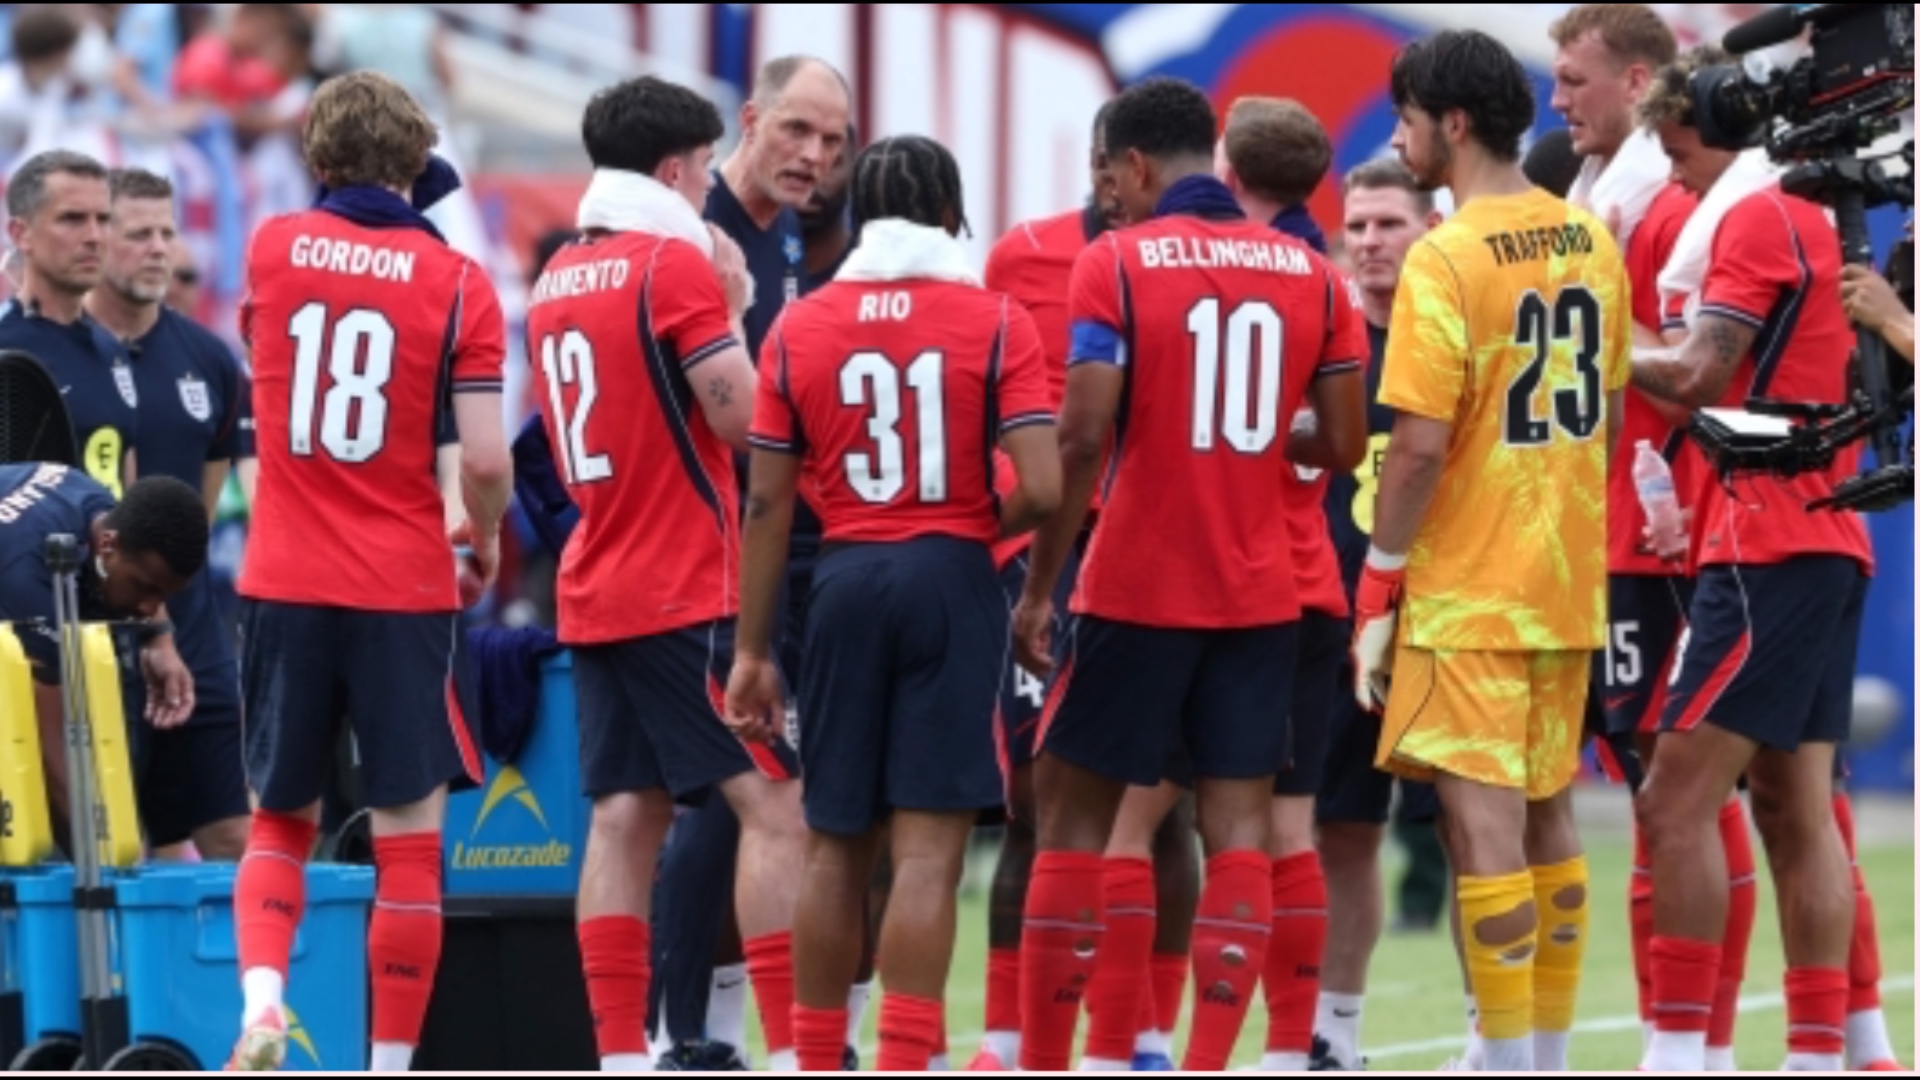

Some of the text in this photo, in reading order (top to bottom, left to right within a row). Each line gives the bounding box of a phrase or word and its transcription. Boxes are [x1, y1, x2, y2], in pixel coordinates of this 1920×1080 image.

[290, 233, 416, 282] GORDON
[1138, 236, 1312, 275] BELLINGHAM
[1483, 222, 1593, 267] TRAFFORD
[532, 257, 630, 303] RAMENTO
[858, 290, 912, 322] RIO
[287, 300, 397, 464] 18
[1187, 296, 1283, 454] 10
[1505, 284, 1602, 446] 23
[540, 327, 614, 486] 12
[839, 350, 947, 505] 31
[1604, 620, 1642, 687] 15
[451, 839, 572, 870] Lucozade
